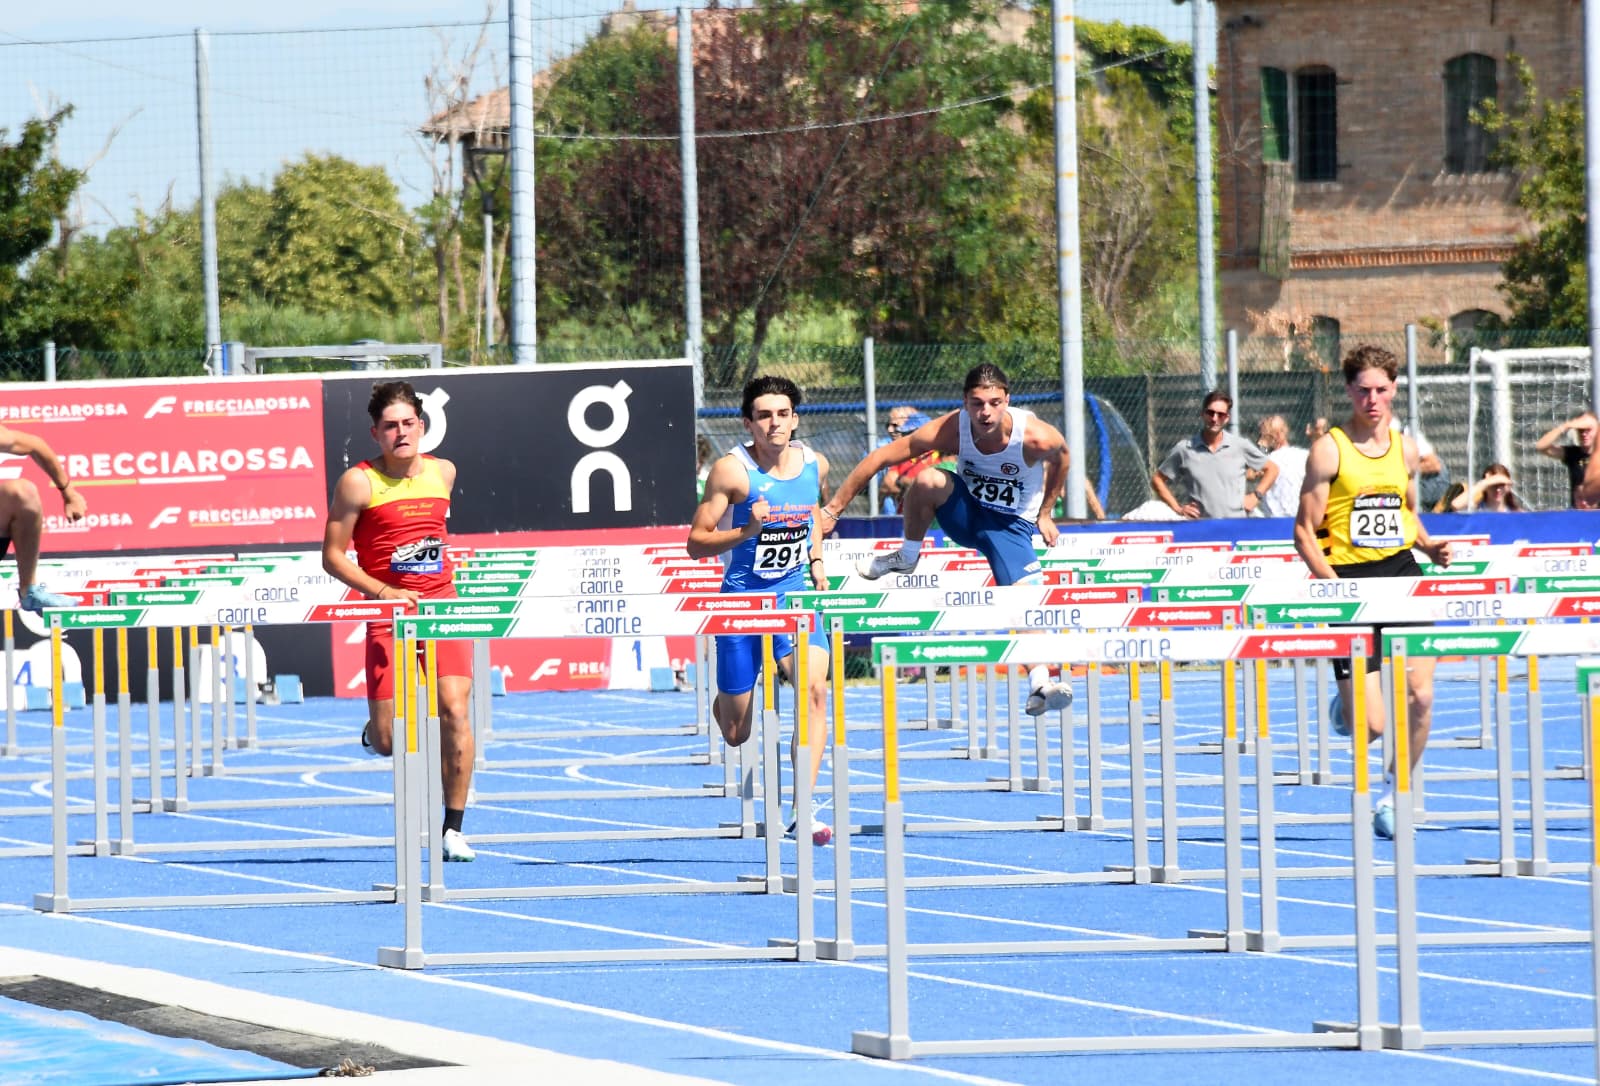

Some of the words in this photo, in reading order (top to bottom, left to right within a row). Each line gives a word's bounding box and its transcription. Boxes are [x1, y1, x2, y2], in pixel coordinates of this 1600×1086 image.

[1, 403, 128, 420] FRECCIAROSSA
[183, 397, 311, 414] FRECCIAROSSA
[972, 478, 1014, 506] 294
[188, 506, 317, 524] FRECCIAROSSA
[1357, 513, 1398, 536] 284
[761, 529, 807, 542] DRIVALIA
[760, 544, 802, 569] 291
[632, 640, 642, 671] 1
